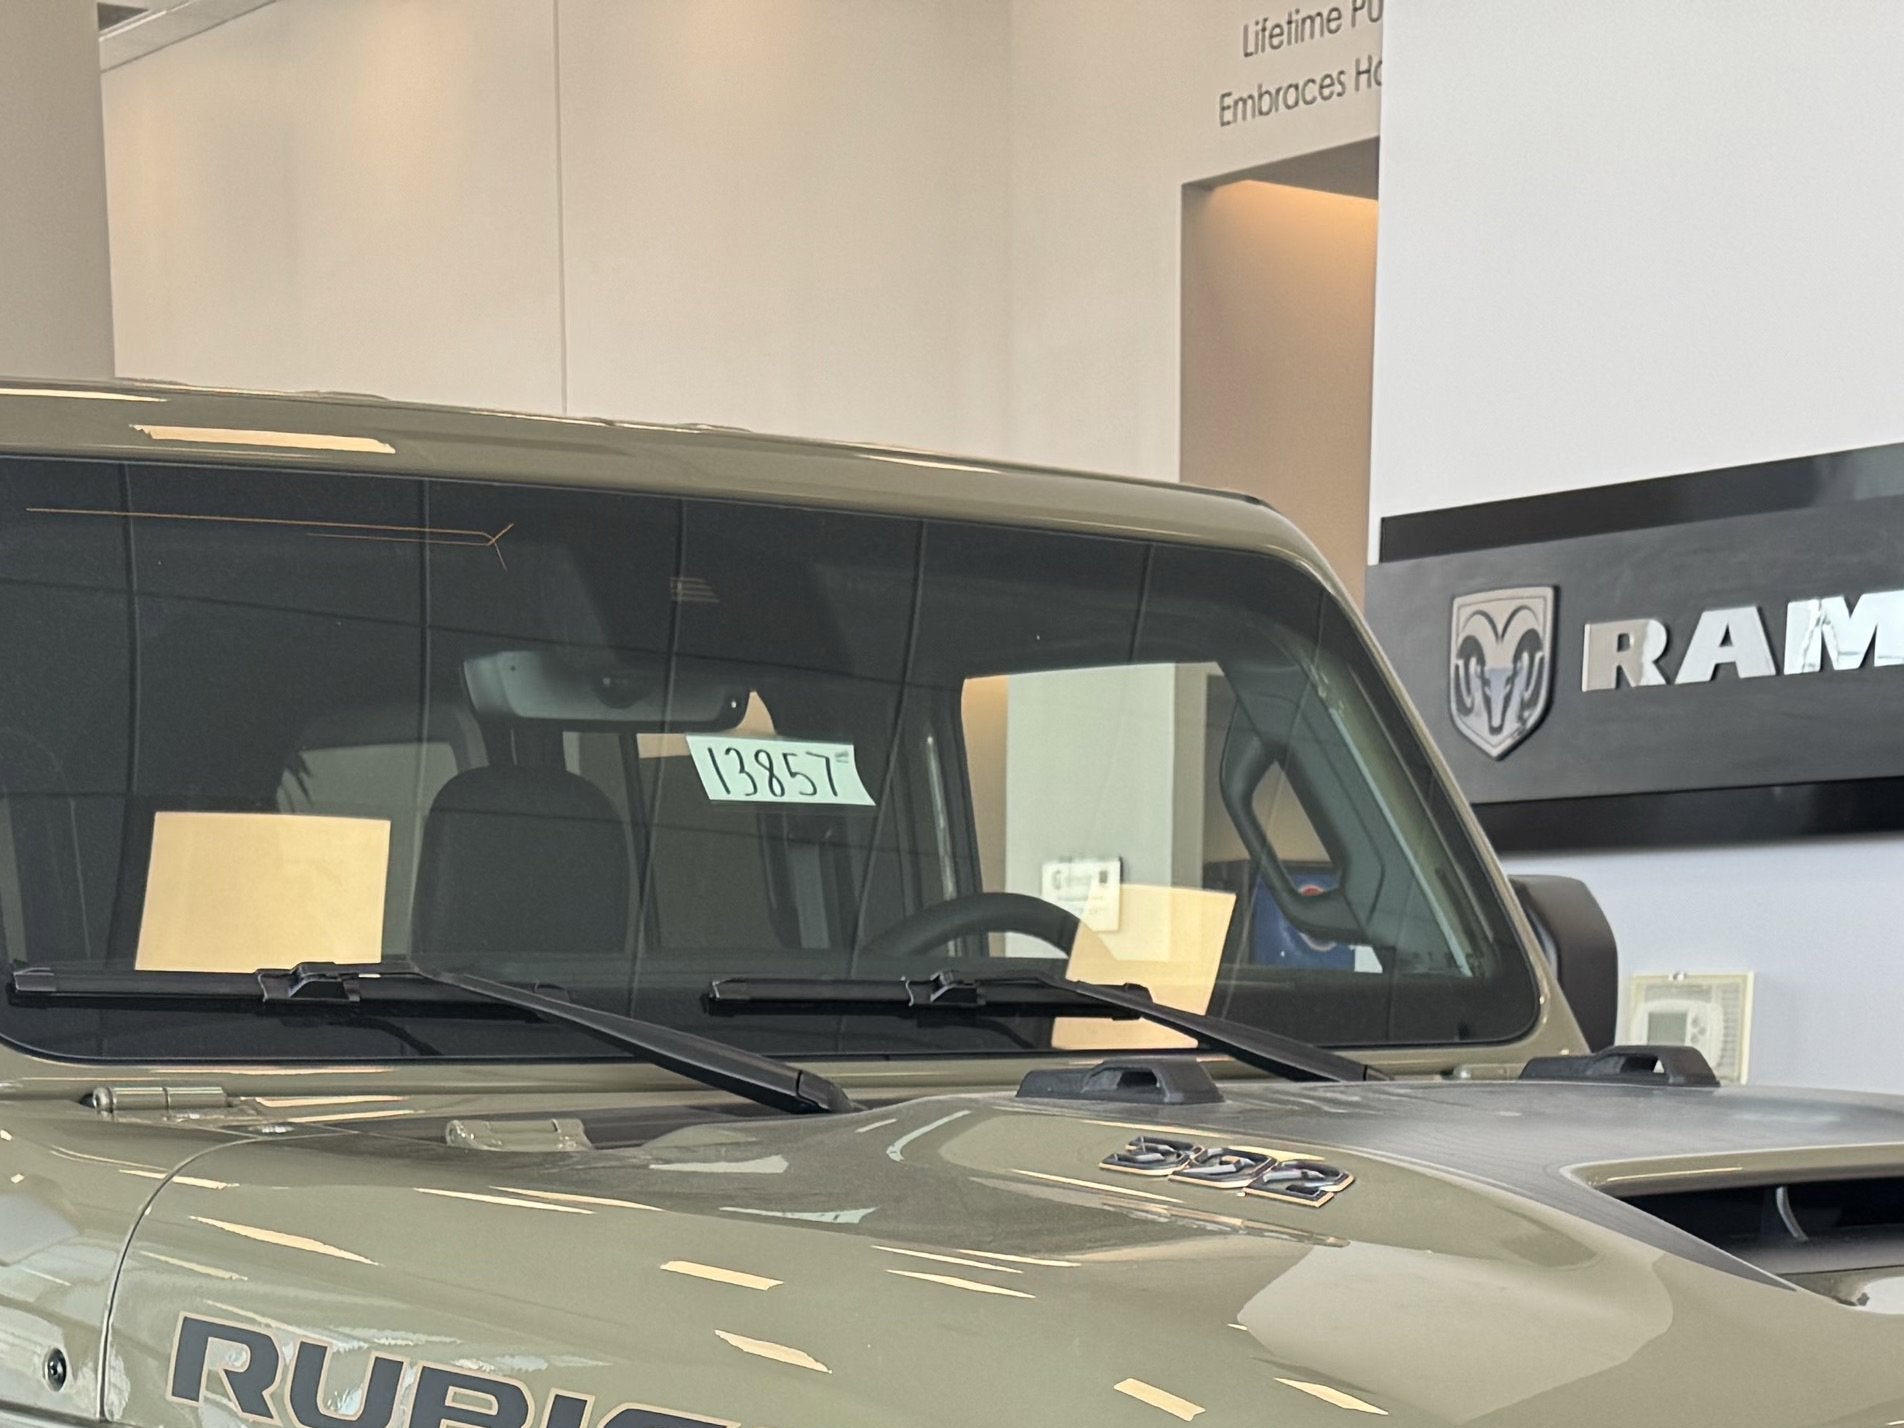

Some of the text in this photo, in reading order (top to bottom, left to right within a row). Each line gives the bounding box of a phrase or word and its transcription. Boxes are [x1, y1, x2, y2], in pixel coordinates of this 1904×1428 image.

[1242, 6, 1343, 58] Lifetime
[1219, 69, 1347, 127] Embraces
[707, 747, 838, 798] 13857
[1098, 1136, 1355, 1208] 392
